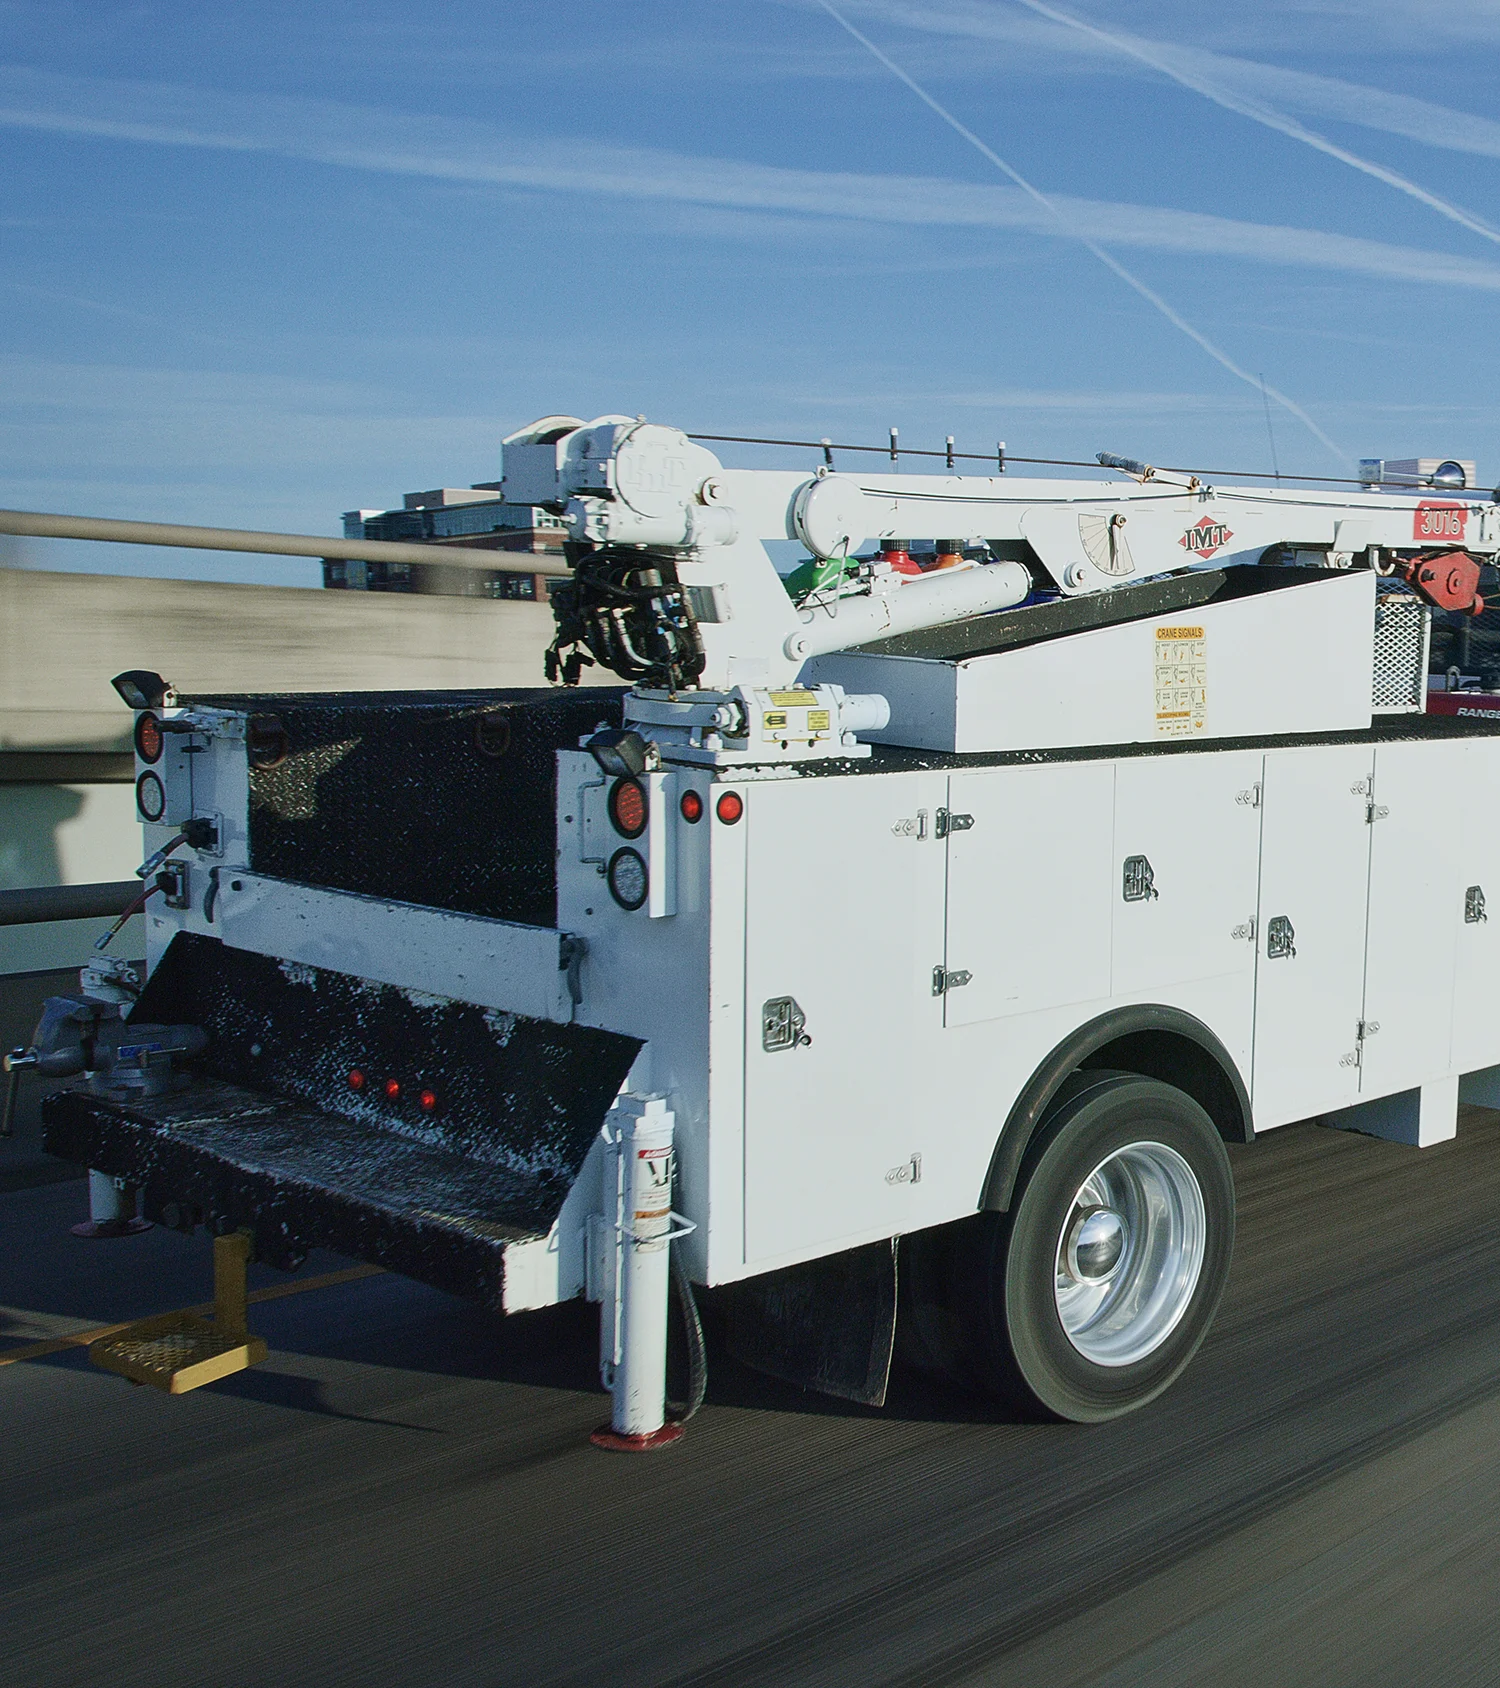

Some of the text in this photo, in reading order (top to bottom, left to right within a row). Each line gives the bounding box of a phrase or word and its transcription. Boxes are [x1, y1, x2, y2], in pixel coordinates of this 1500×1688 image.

[1420, 506, 1461, 535] 3016
[1184, 523, 1227, 551] IMT
[1157, 627, 1202, 639] CRANE SIGNALS
